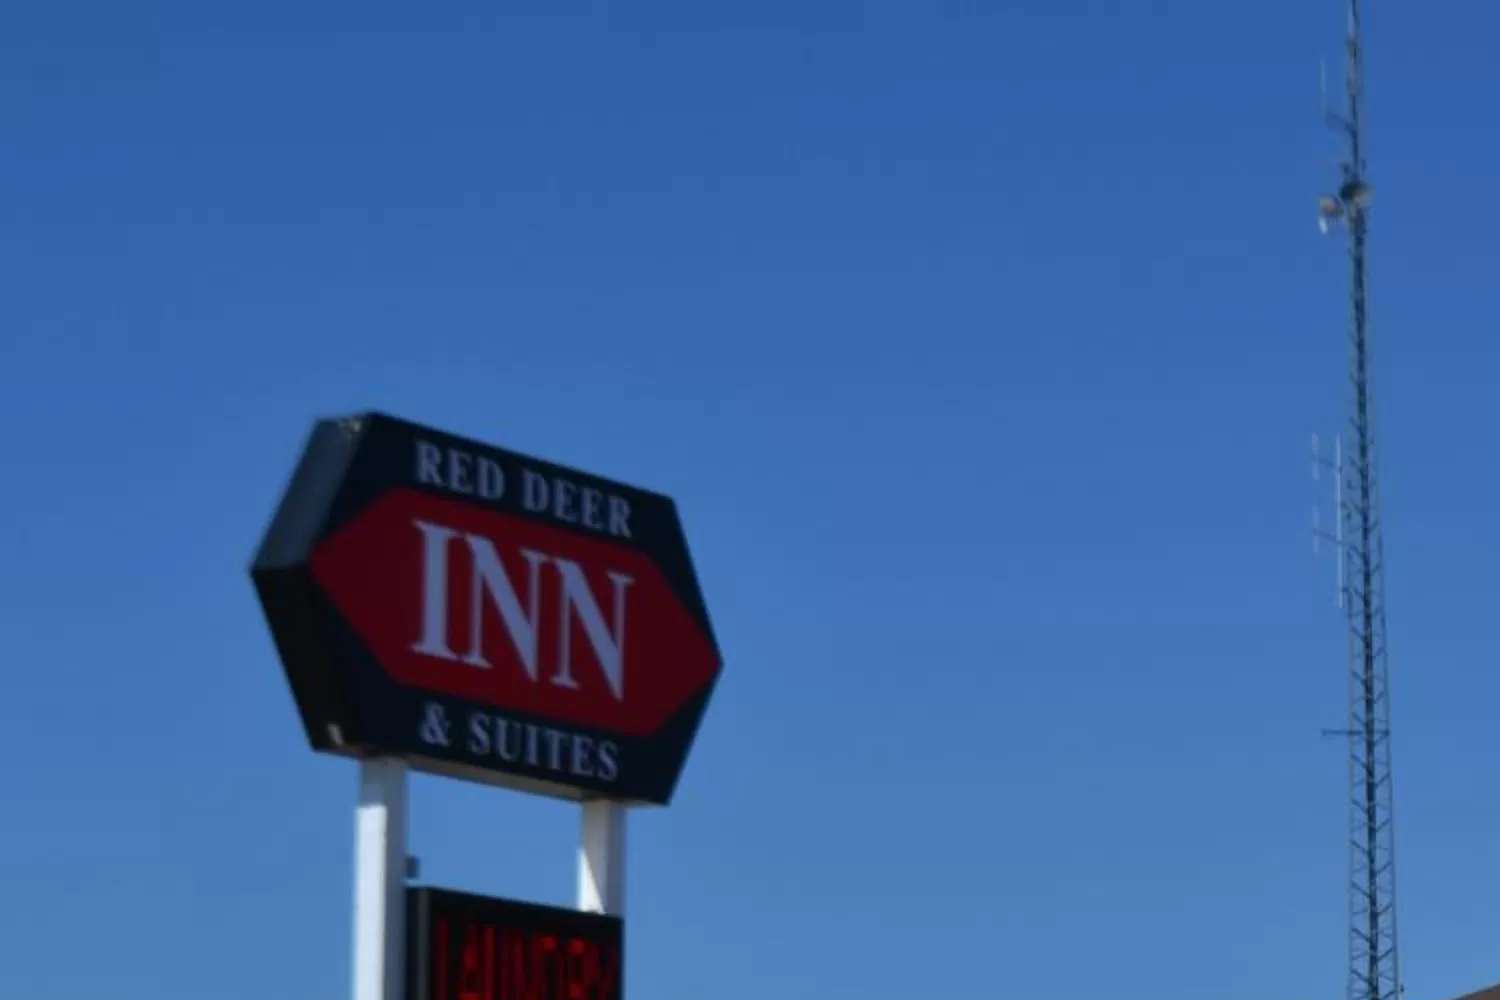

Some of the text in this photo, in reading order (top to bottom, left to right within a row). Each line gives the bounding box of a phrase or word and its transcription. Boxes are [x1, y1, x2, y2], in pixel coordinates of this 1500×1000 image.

[414, 440, 633, 538] RED DEER
[411, 518, 636, 703] INN
[420, 702, 620, 783] & SUITES
